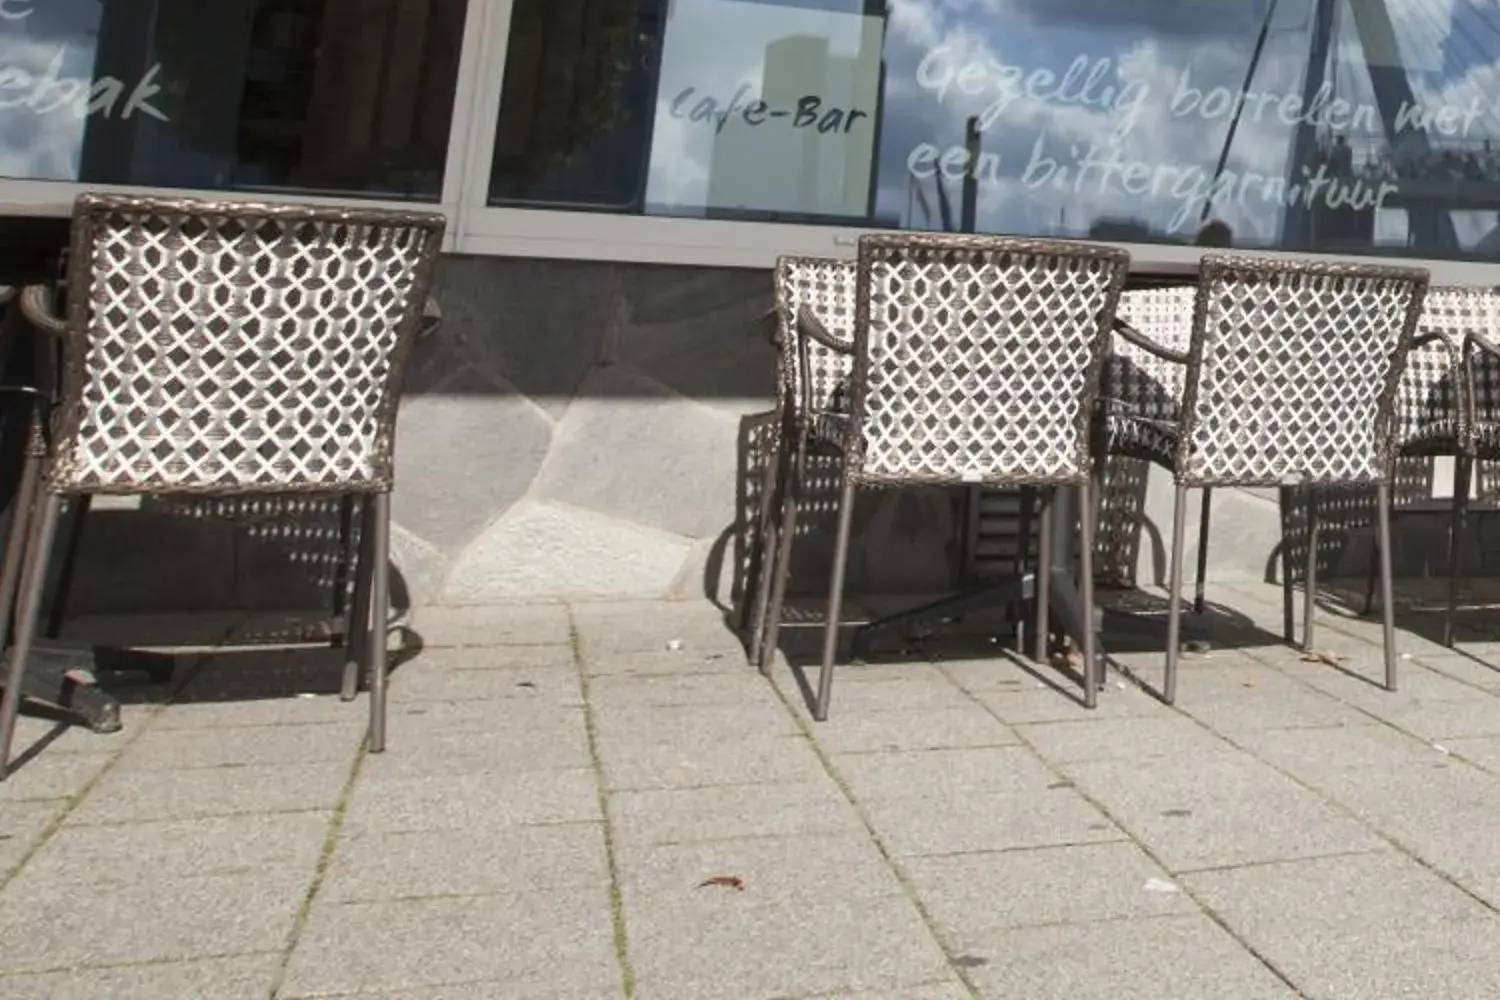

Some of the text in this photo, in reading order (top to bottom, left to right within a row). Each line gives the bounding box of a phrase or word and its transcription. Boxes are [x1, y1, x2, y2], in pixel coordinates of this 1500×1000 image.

[1171, 63, 1379, 133] borrelen
[1396, 95, 1484, 138] met
[906, 129, 1400, 232] een bittergarnituur
